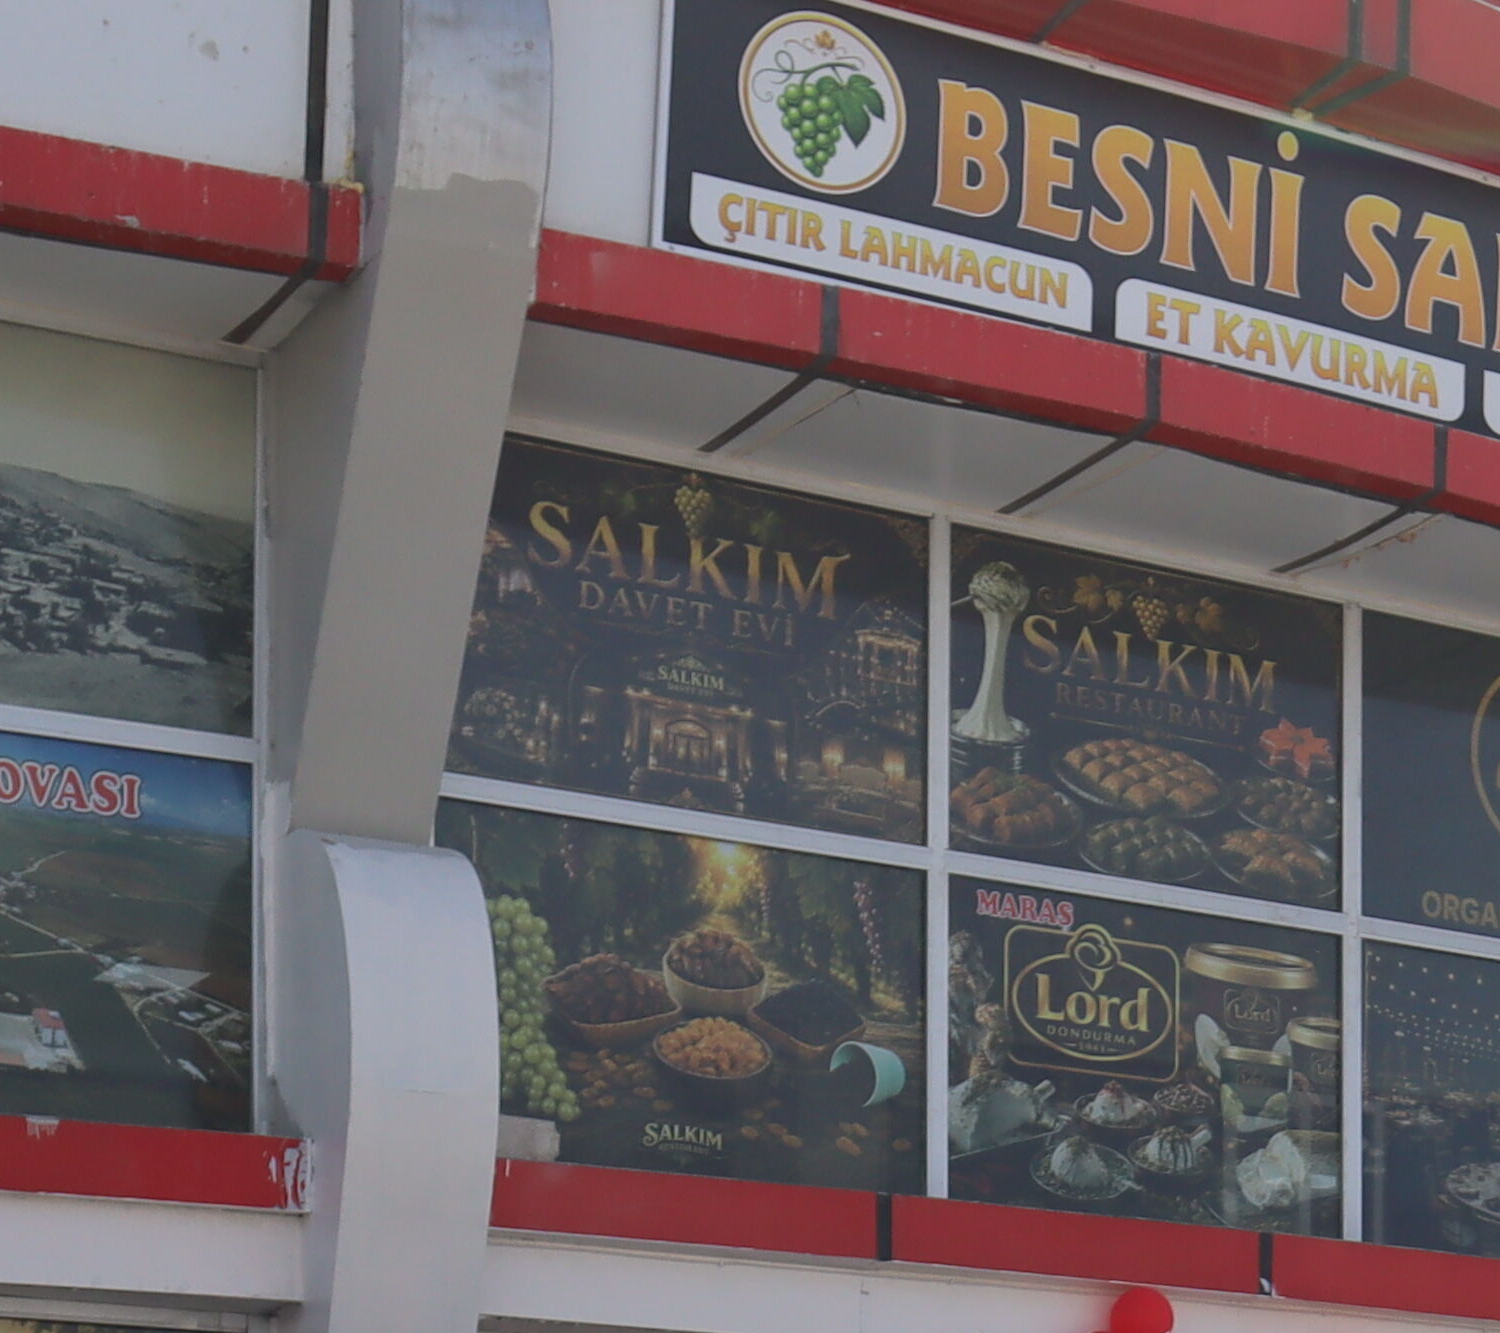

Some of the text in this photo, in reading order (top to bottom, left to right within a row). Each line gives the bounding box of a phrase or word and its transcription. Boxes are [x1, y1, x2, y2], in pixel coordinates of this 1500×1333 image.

[932, 79, 1303, 297] BESNİ
[717, 192, 1069, 309] ÇITIR LAHMACUN
[1143, 291, 1440, 409] ET KAVURMA
[528, 500, 851, 620] SALKIM
[579, 581, 712, 631] DAVET
[657, 664, 724, 692] SALKIM
[1022, 614, 1276, 717] SALKIM
[1055, 681, 1249, 737] RESTAURANT
[1036, 973, 1150, 1033] Lord
[1045, 1023, 1138, 1046] DONDURMA
[643, 1121, 724, 1152] SALKIM
